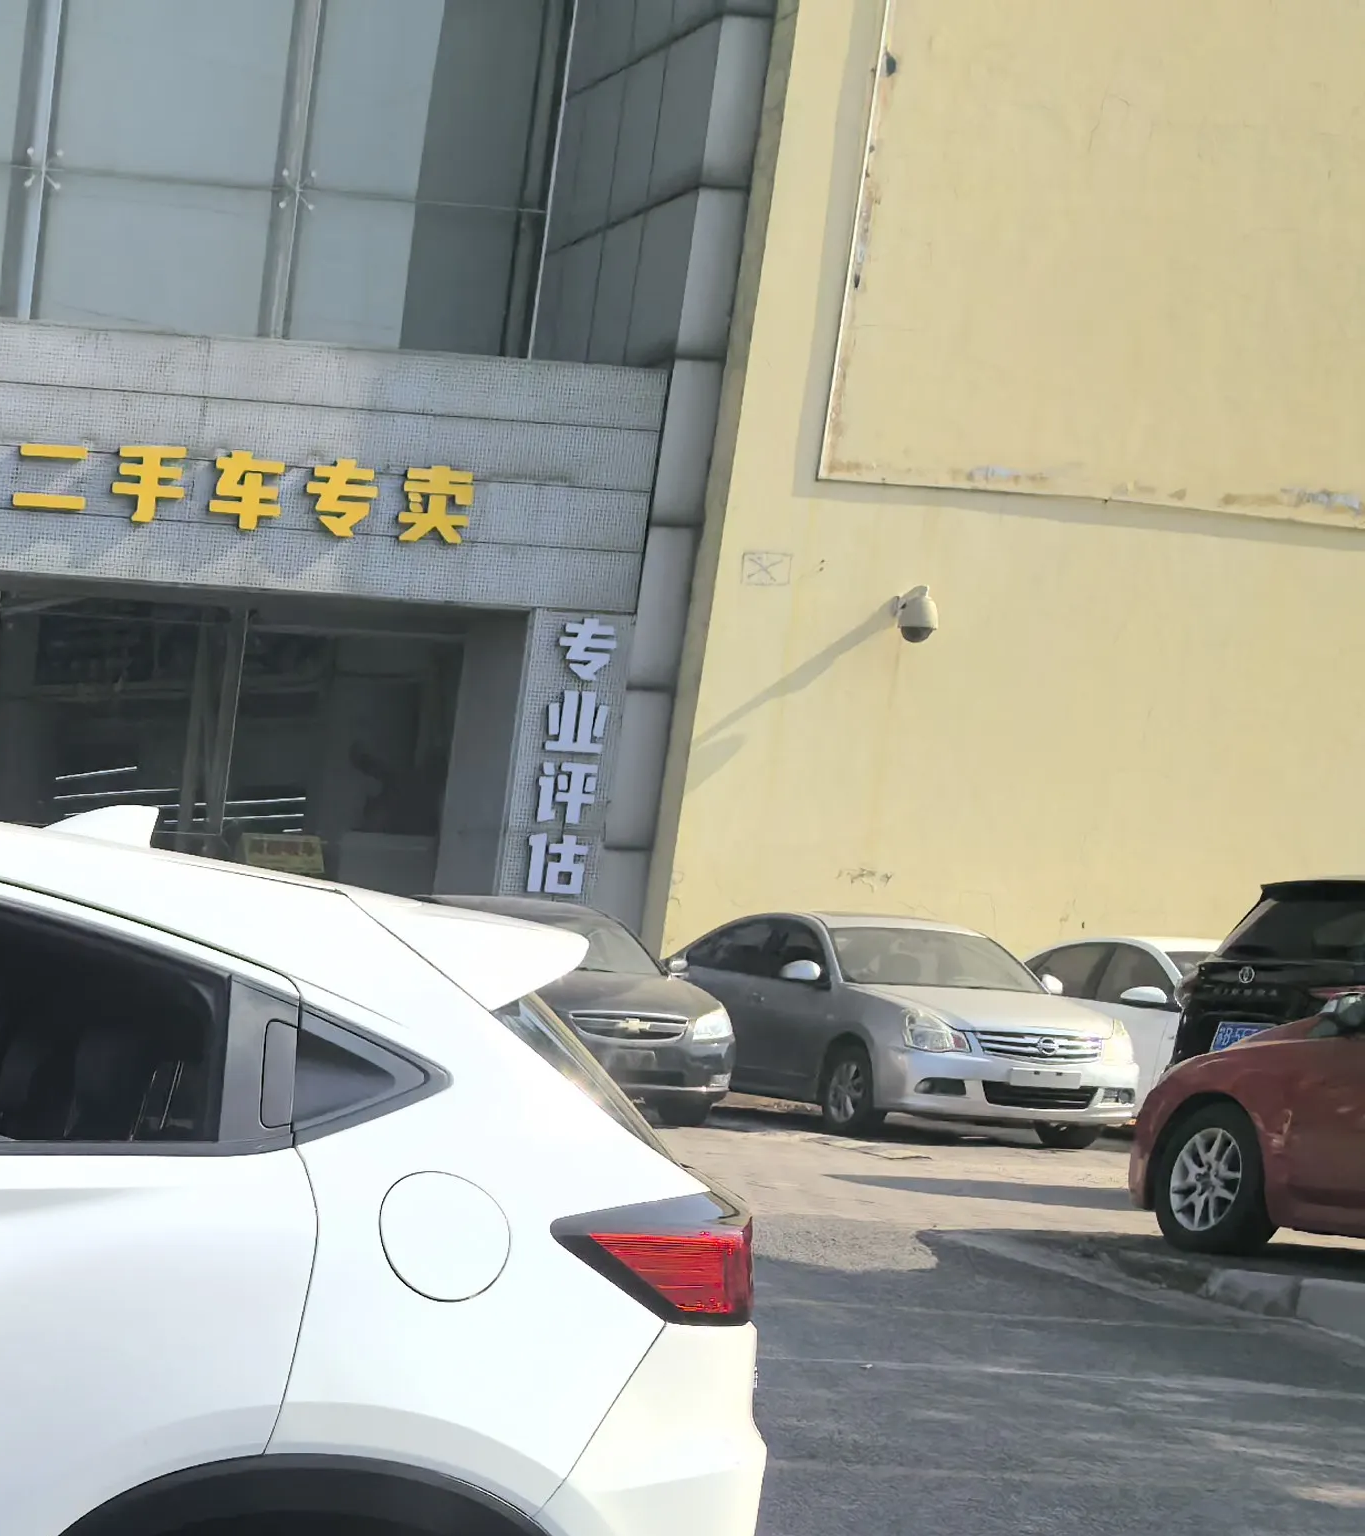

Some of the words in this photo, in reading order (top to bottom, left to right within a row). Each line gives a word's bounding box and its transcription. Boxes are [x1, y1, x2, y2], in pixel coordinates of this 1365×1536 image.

[12, 443, 475, 545] 二手车专卖
[526, 617, 618, 895] 专业评估
